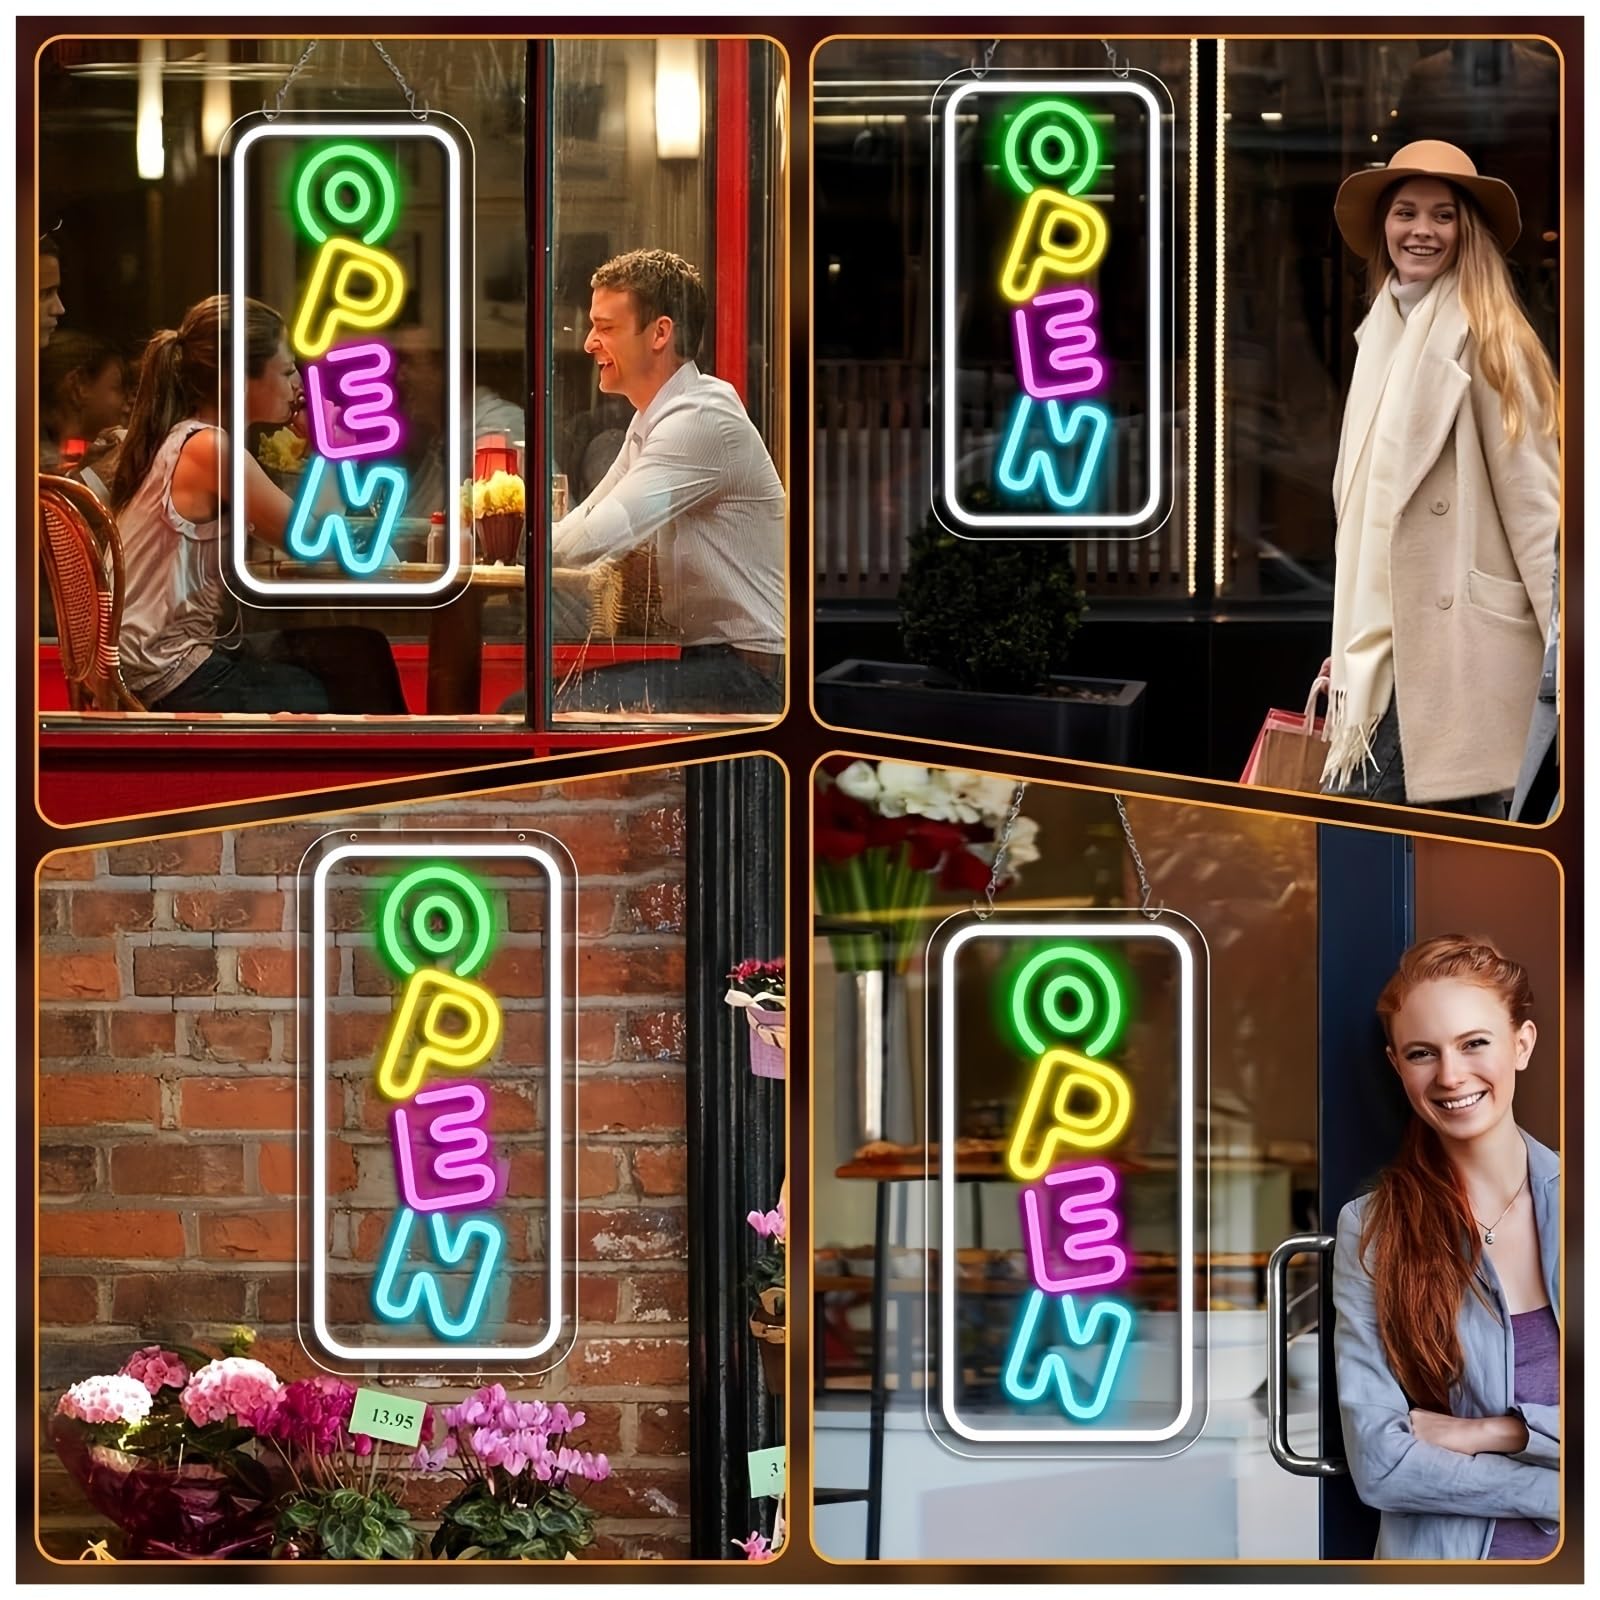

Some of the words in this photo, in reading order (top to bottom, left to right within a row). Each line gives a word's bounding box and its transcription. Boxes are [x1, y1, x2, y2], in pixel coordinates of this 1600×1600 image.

[291, 144, 405, 574] OPEN
[1000, 100, 1107, 507] OPEN
[376, 866, 501, 1337] OPEN
[1005, 946, 1131, 1419] OPEN
[372, 1408, 414, 1430] 13.95
